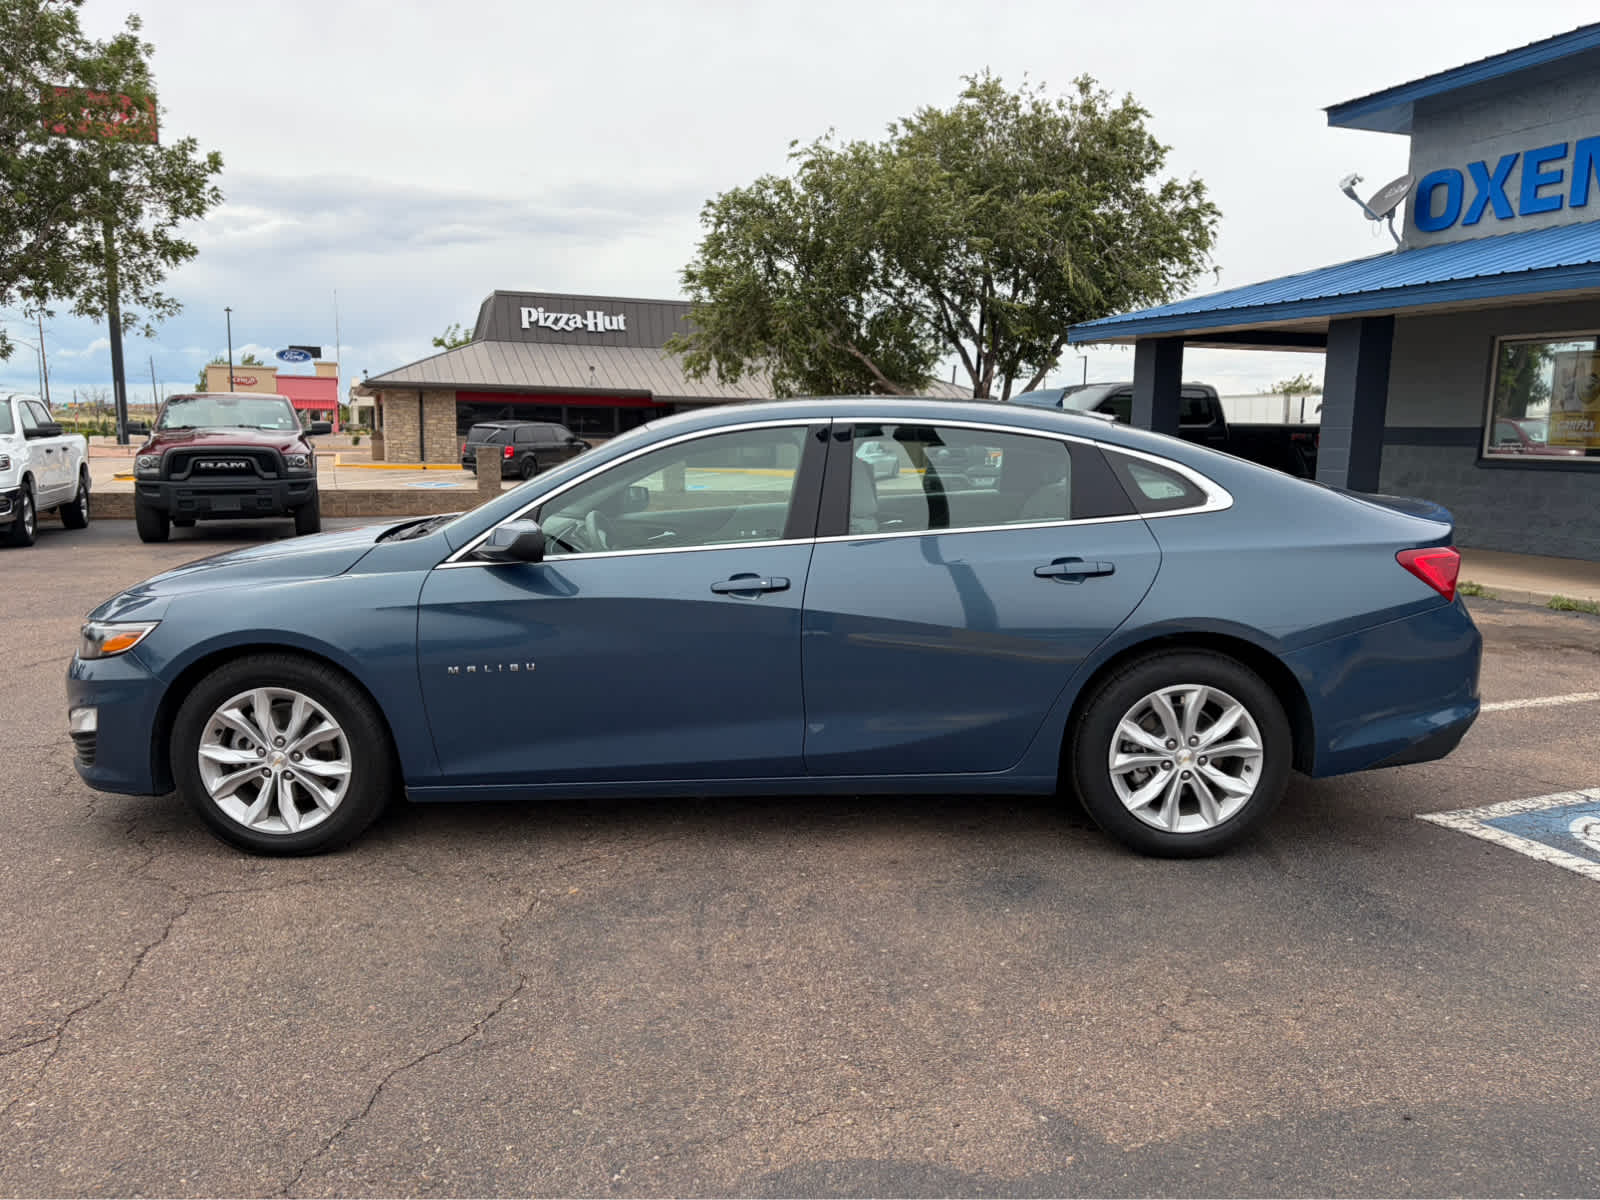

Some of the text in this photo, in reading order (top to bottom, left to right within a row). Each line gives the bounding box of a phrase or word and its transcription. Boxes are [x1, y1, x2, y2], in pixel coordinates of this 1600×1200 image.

[520, 306, 626, 332] Pizza Hut
[448, 663, 535, 674] MALIBU
